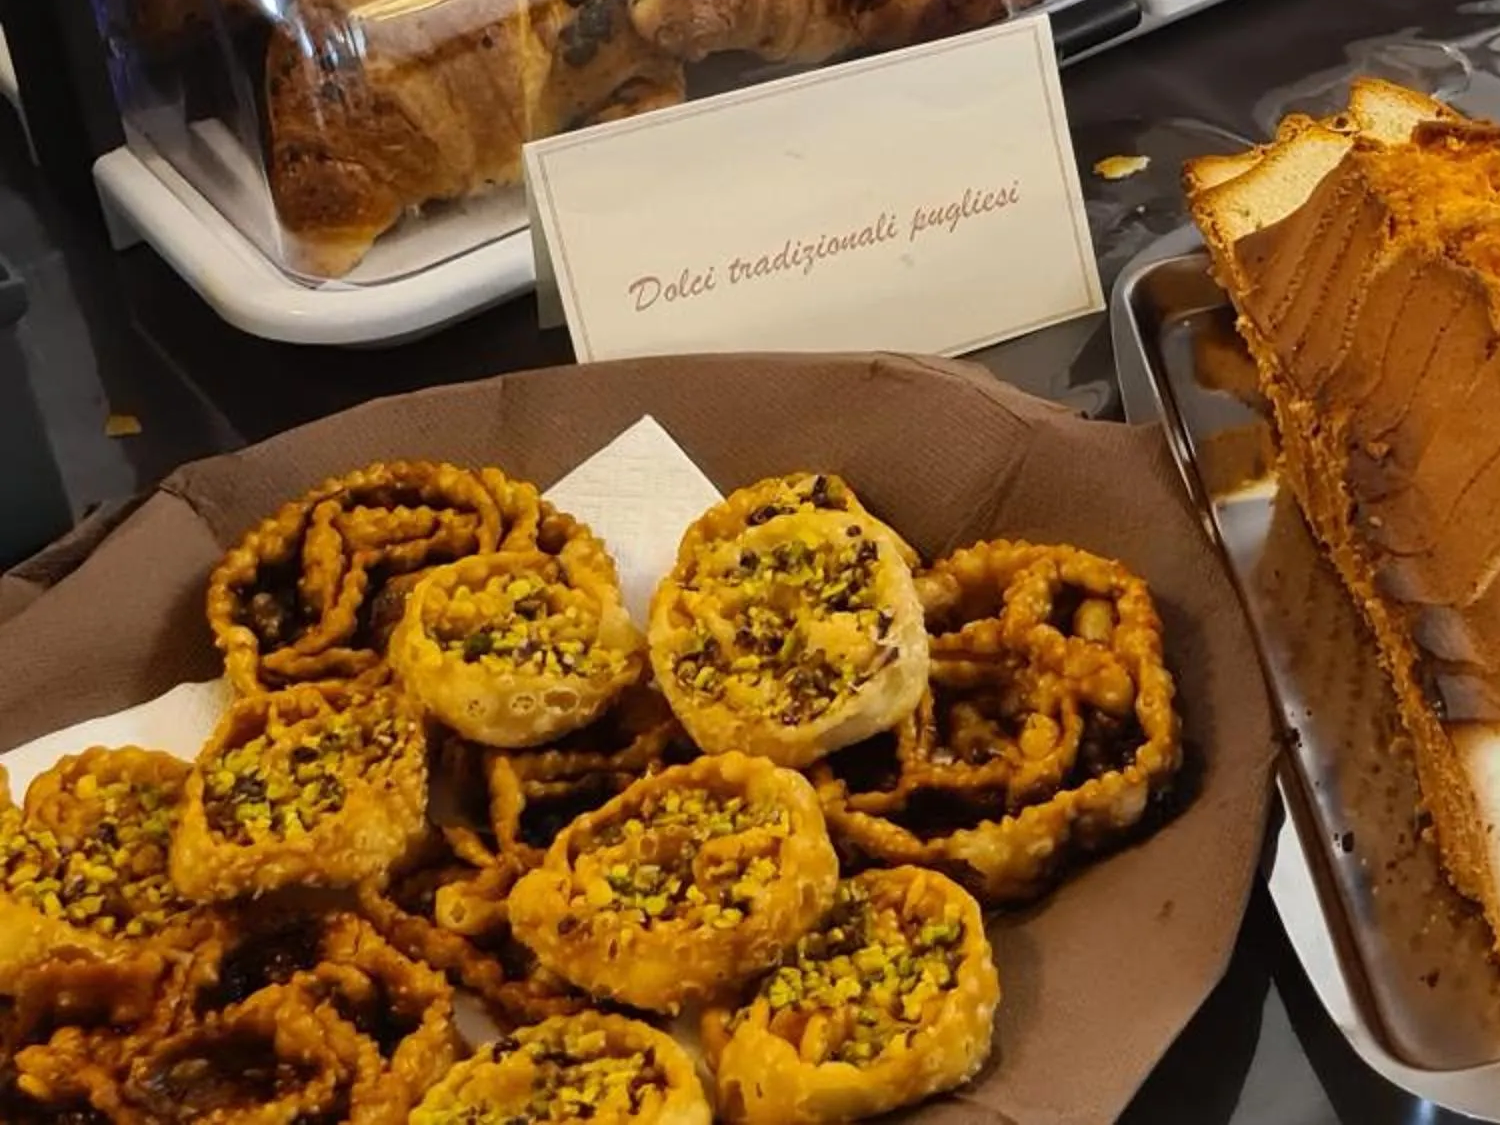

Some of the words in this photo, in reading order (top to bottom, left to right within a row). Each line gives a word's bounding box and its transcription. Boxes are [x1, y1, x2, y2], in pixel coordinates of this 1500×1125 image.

[628, 265, 717, 312] Dolci
[728, 213, 898, 283] tradizionali
[909, 179, 1021, 239] pugliesi
